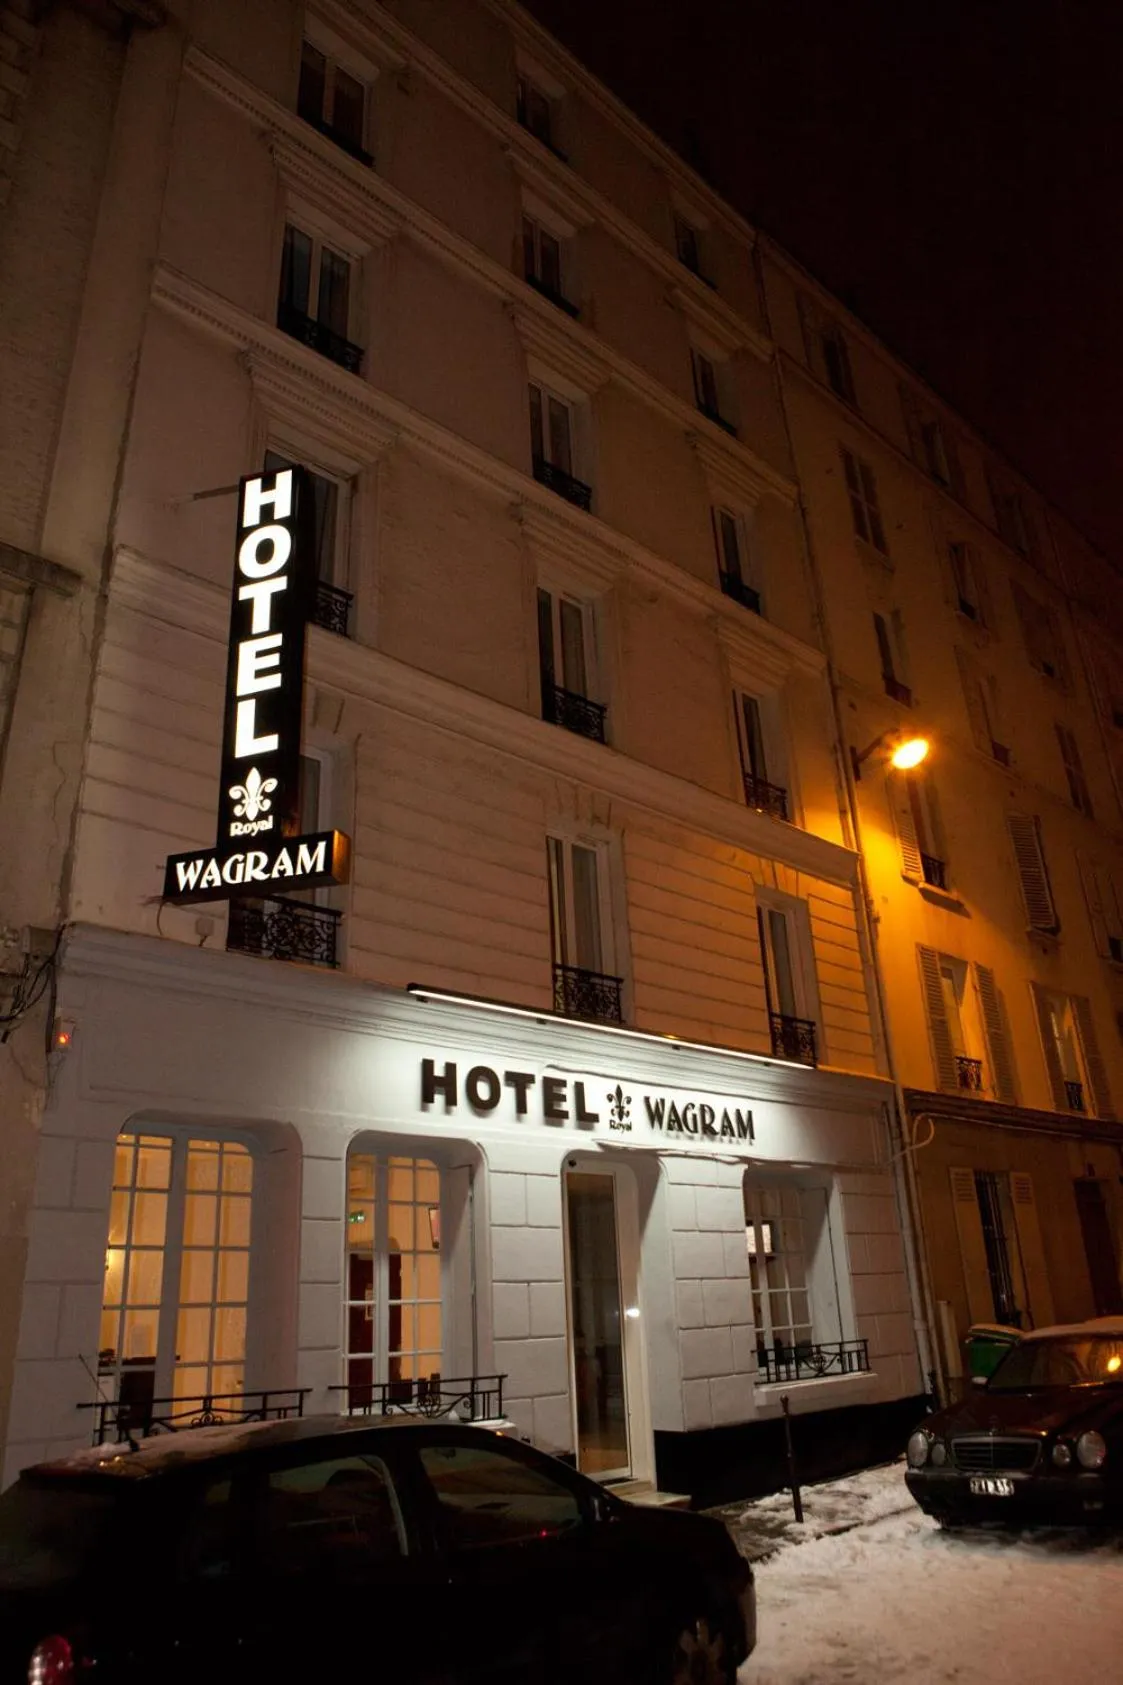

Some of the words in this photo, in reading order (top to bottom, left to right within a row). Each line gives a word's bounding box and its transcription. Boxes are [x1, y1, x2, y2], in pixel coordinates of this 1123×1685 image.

[234, 469, 293, 759] HOTEL
[229, 815, 274, 837] Royal
[175, 841, 327, 892] WAGRAM
[421, 1058, 599, 1124] HOTEL
[644, 1096, 756, 1139] WAGRAM
[609, 1119, 633, 1133] Royal
